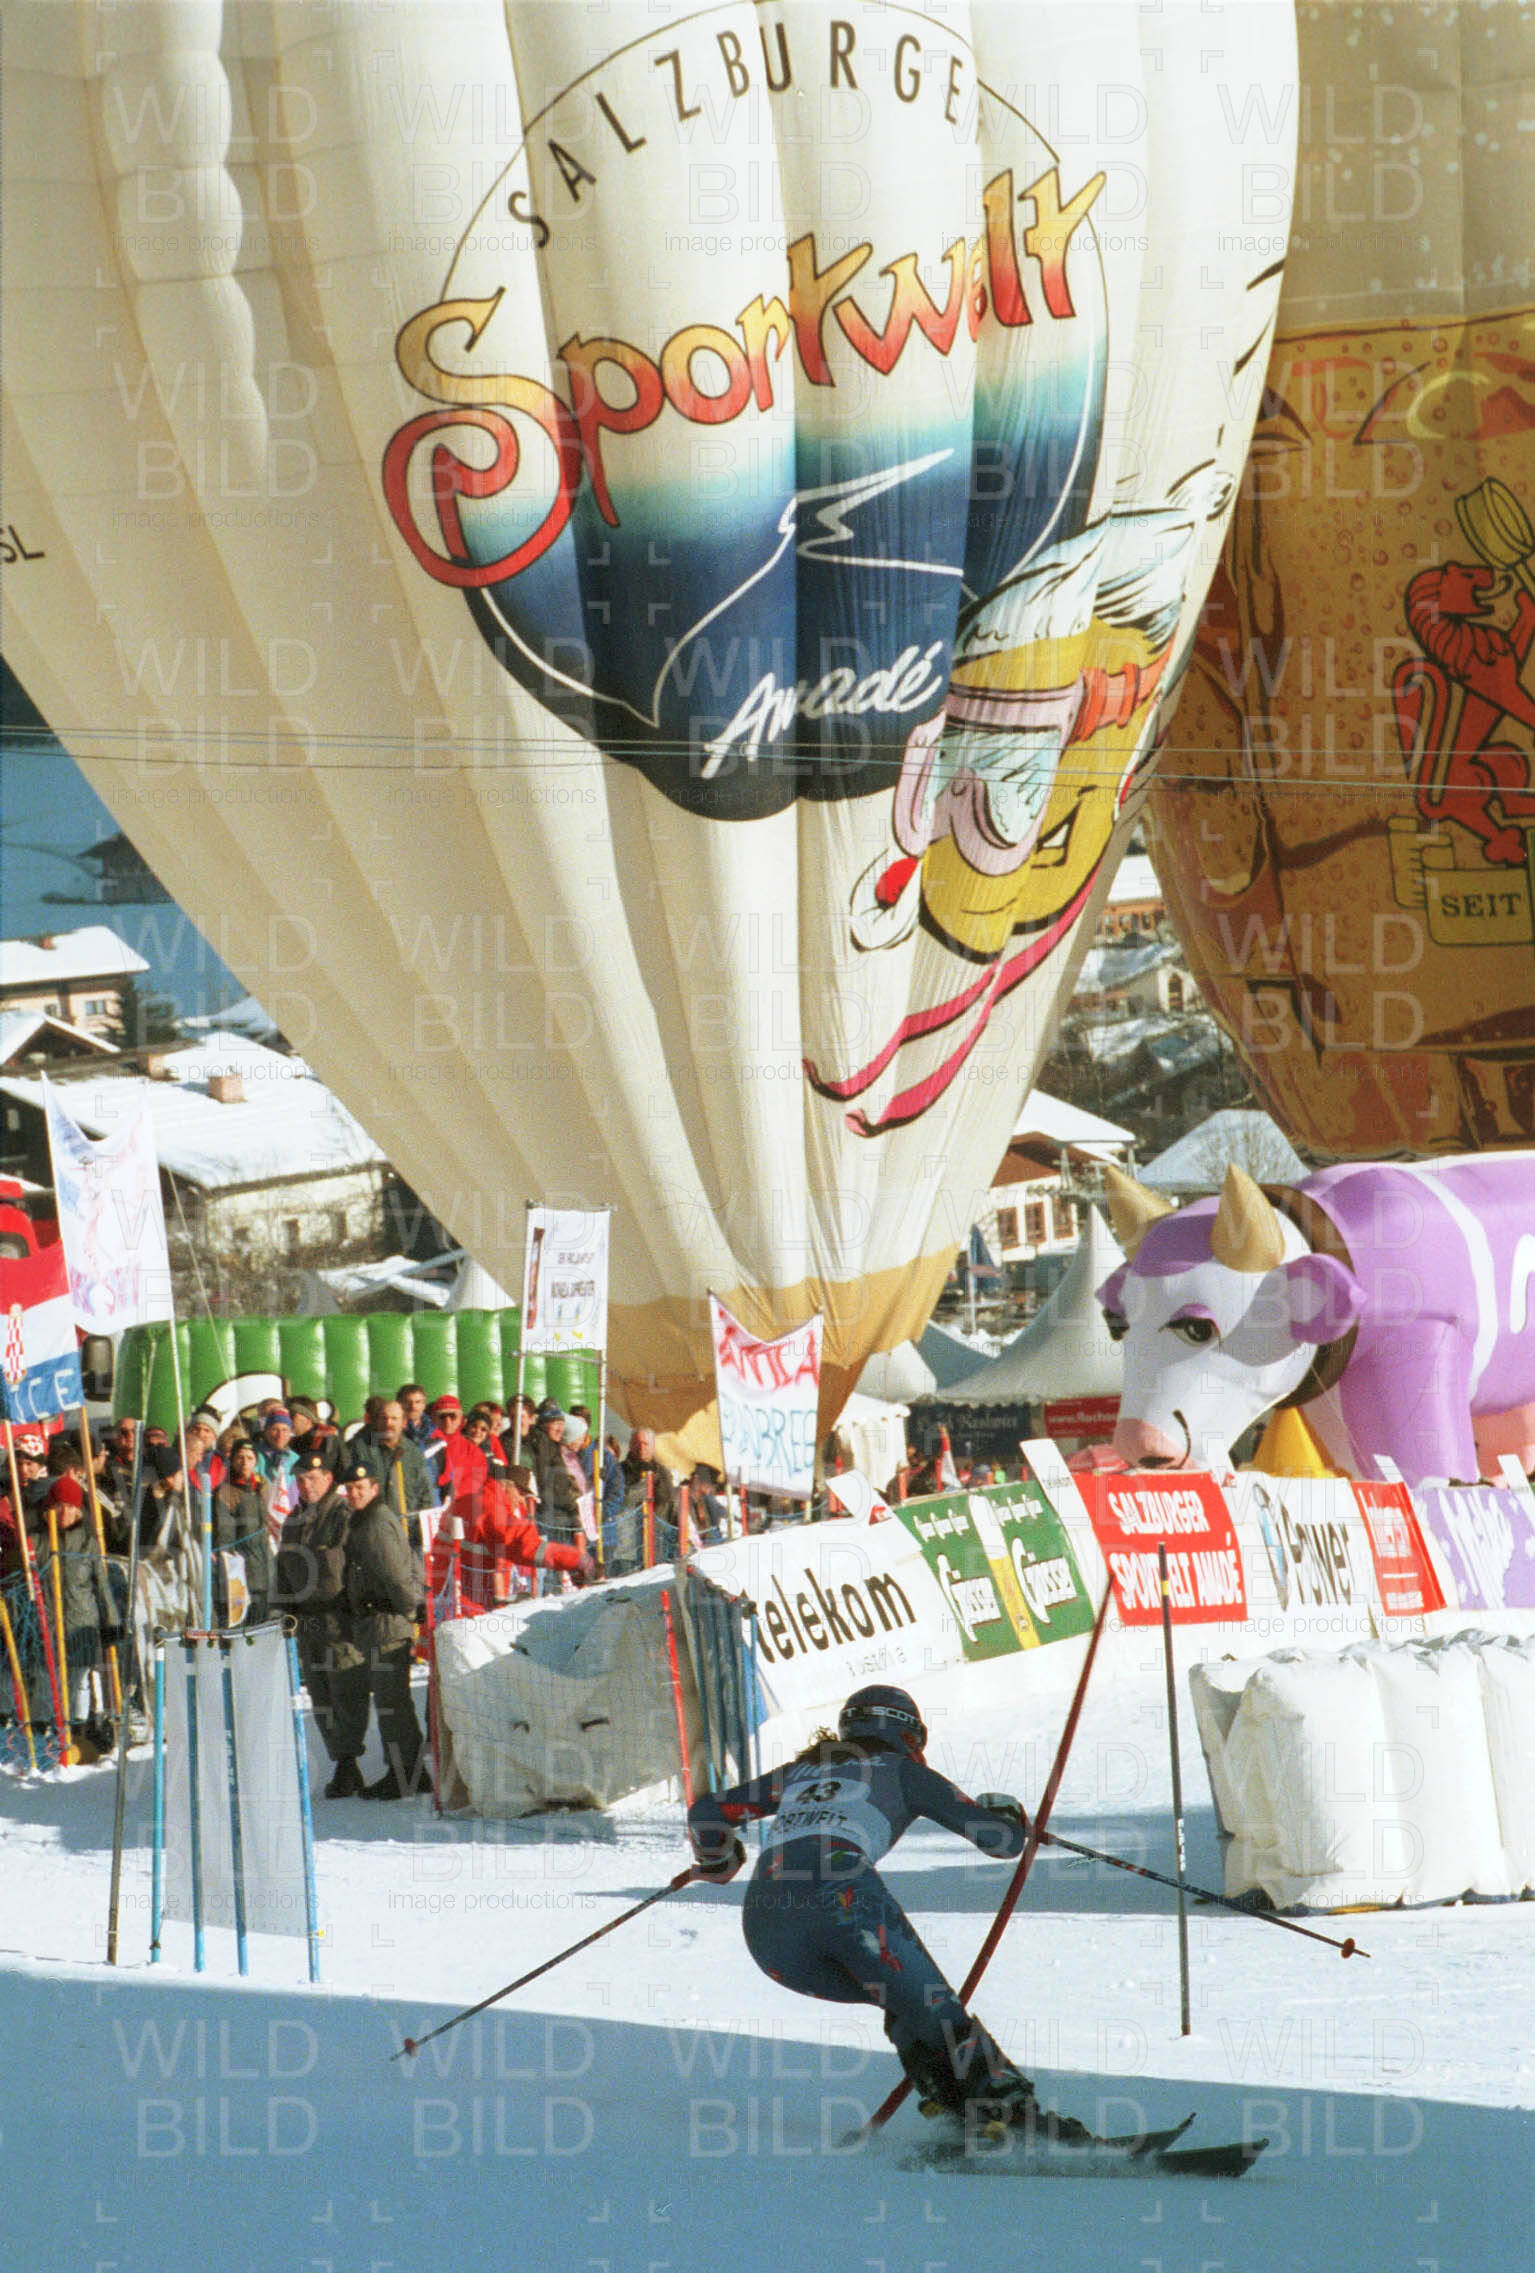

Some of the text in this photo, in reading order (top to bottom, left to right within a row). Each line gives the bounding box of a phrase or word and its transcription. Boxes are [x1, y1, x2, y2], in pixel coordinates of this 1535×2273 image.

[507, 19, 984, 249] SALZBURGE
[1441, 893, 1521, 917] SEIT
[1107, 1490, 1211, 1535] SALZBURGER
[1191, 1530, 1243, 1608] AMADÉ
[871, 1705, 919, 1725] SCOT
